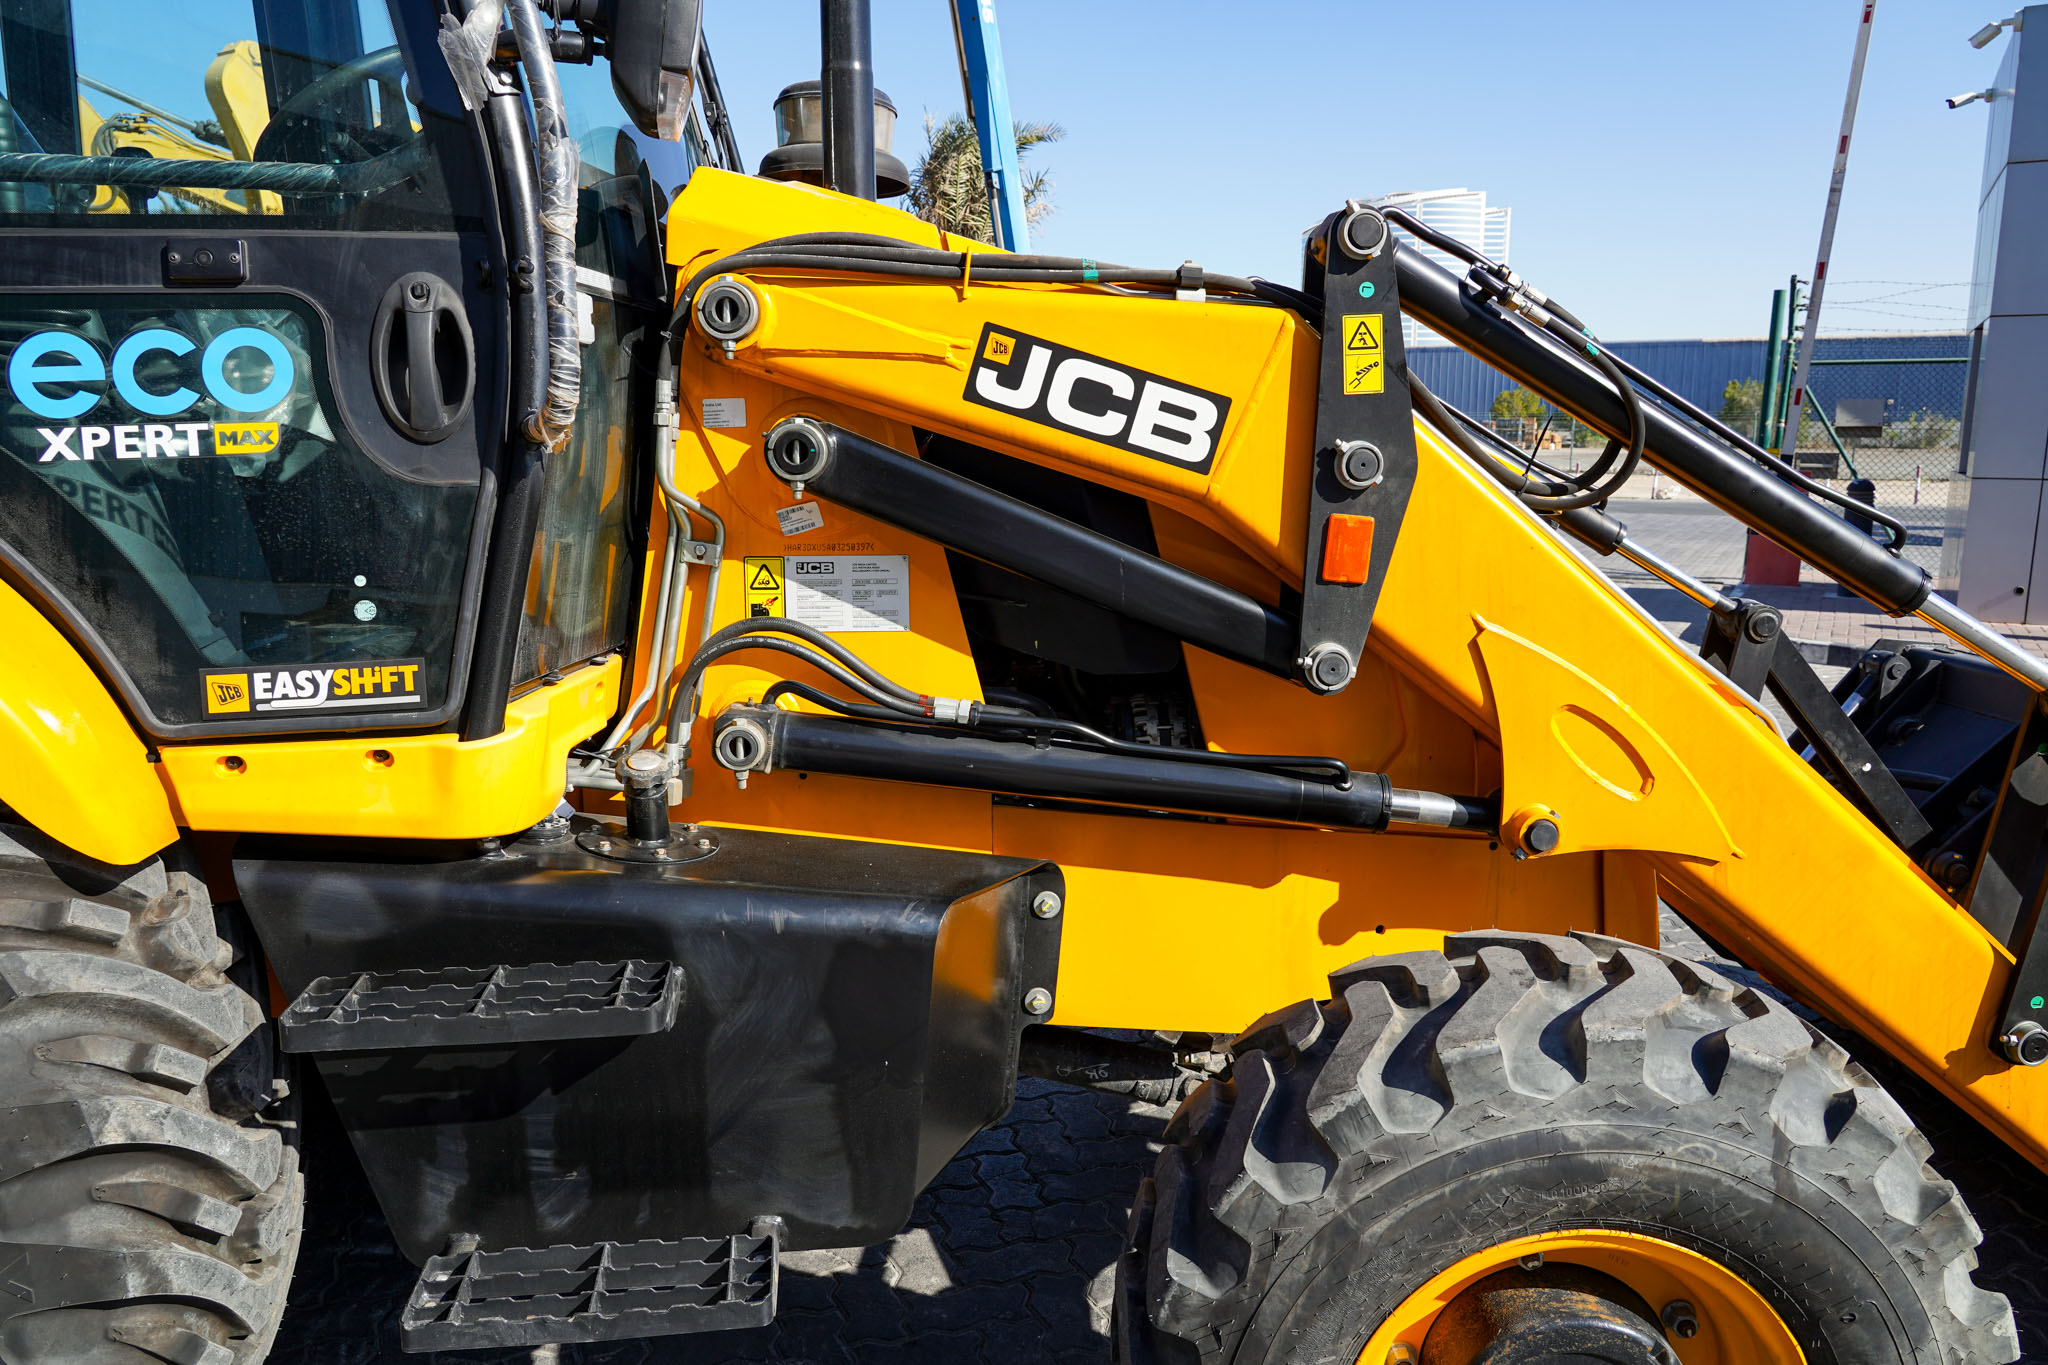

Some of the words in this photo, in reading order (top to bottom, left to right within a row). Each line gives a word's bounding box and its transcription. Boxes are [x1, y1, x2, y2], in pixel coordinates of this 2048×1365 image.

[993, 341, 1008, 355] JCB
[9, 327, 294, 419] eco
[975, 344, 1218, 462] JCB
[37, 423, 208, 461] XPERT
[219, 430, 274, 446] MAX
[797, 562, 834, 574] JCB
[217, 684, 242, 703] JCB
